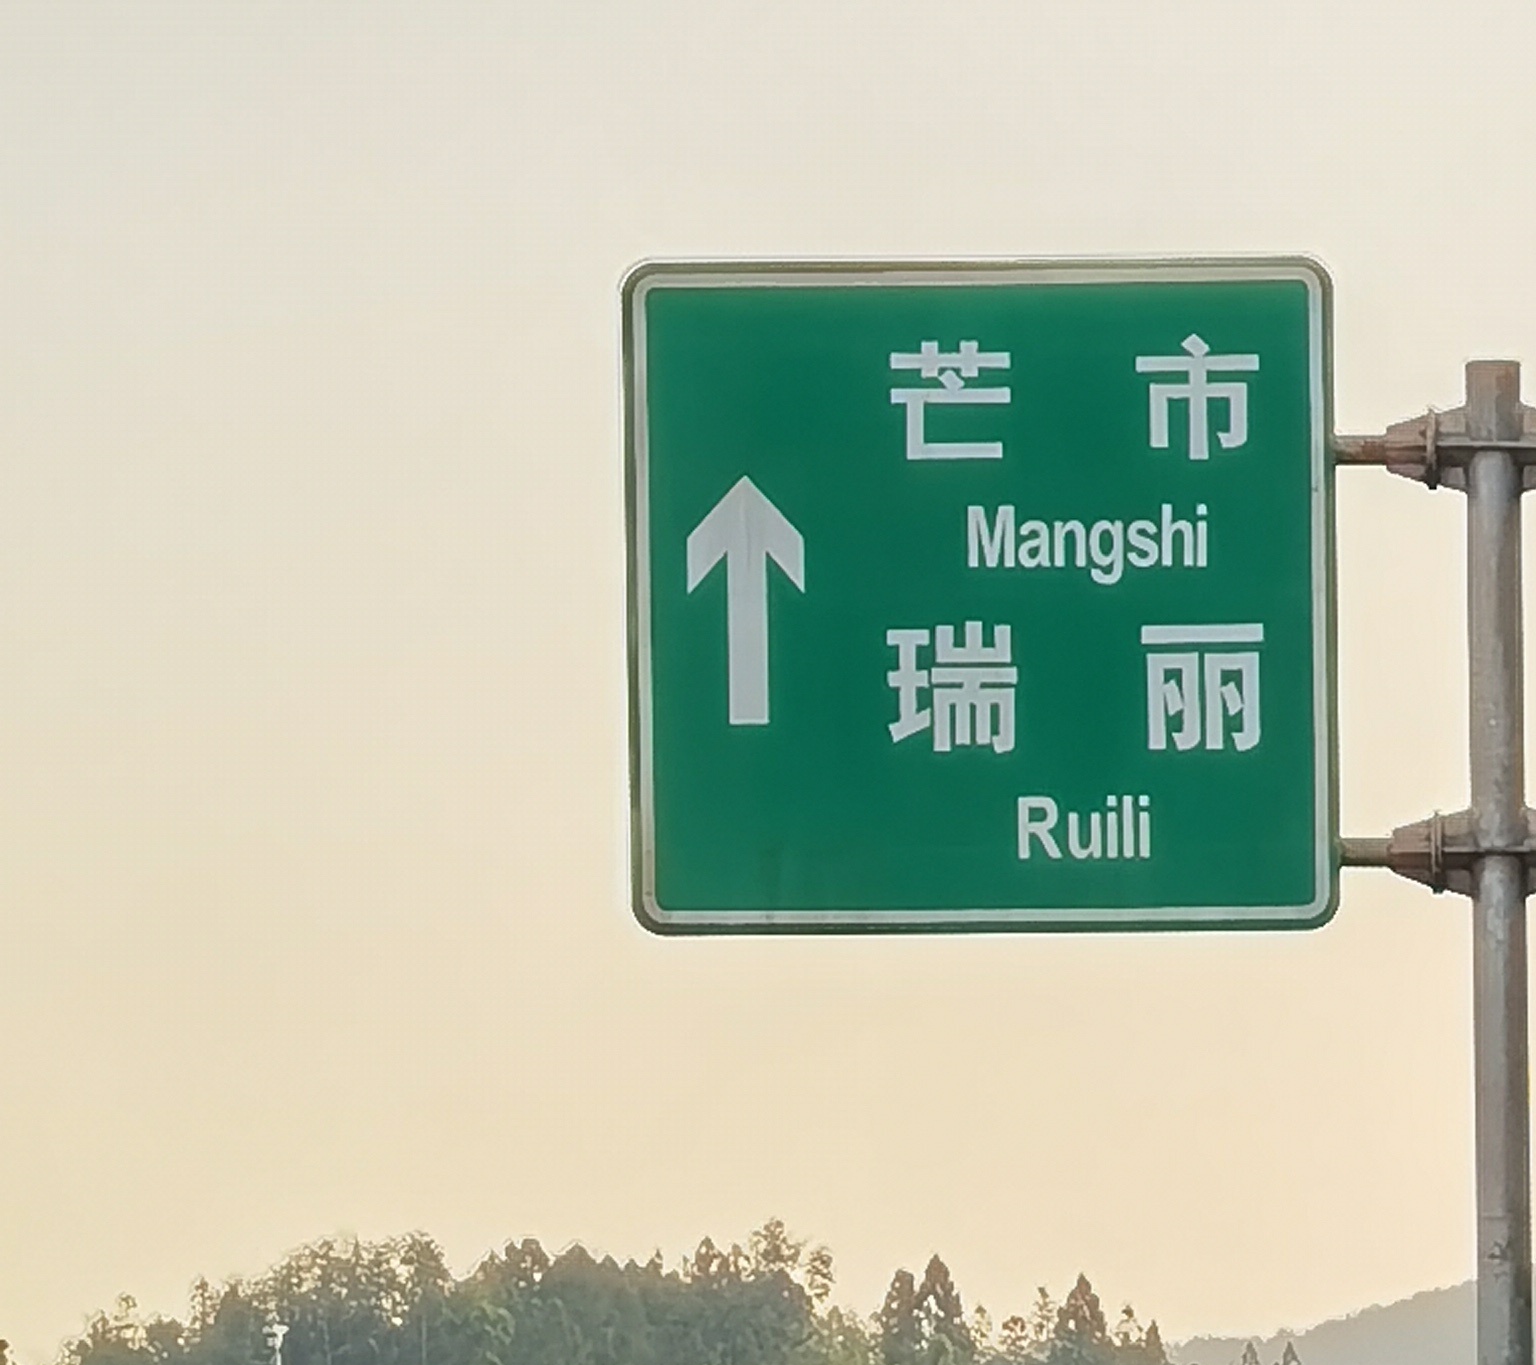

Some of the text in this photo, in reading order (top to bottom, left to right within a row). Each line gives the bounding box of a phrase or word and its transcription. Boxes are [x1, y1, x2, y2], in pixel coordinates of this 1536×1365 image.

[890, 333, 1260, 460] 芒市
[966, 503, 1208, 584] Mangshi
[887, 620, 1264, 753] 瑞丽
[1017, 795, 1151, 860] Ruili
